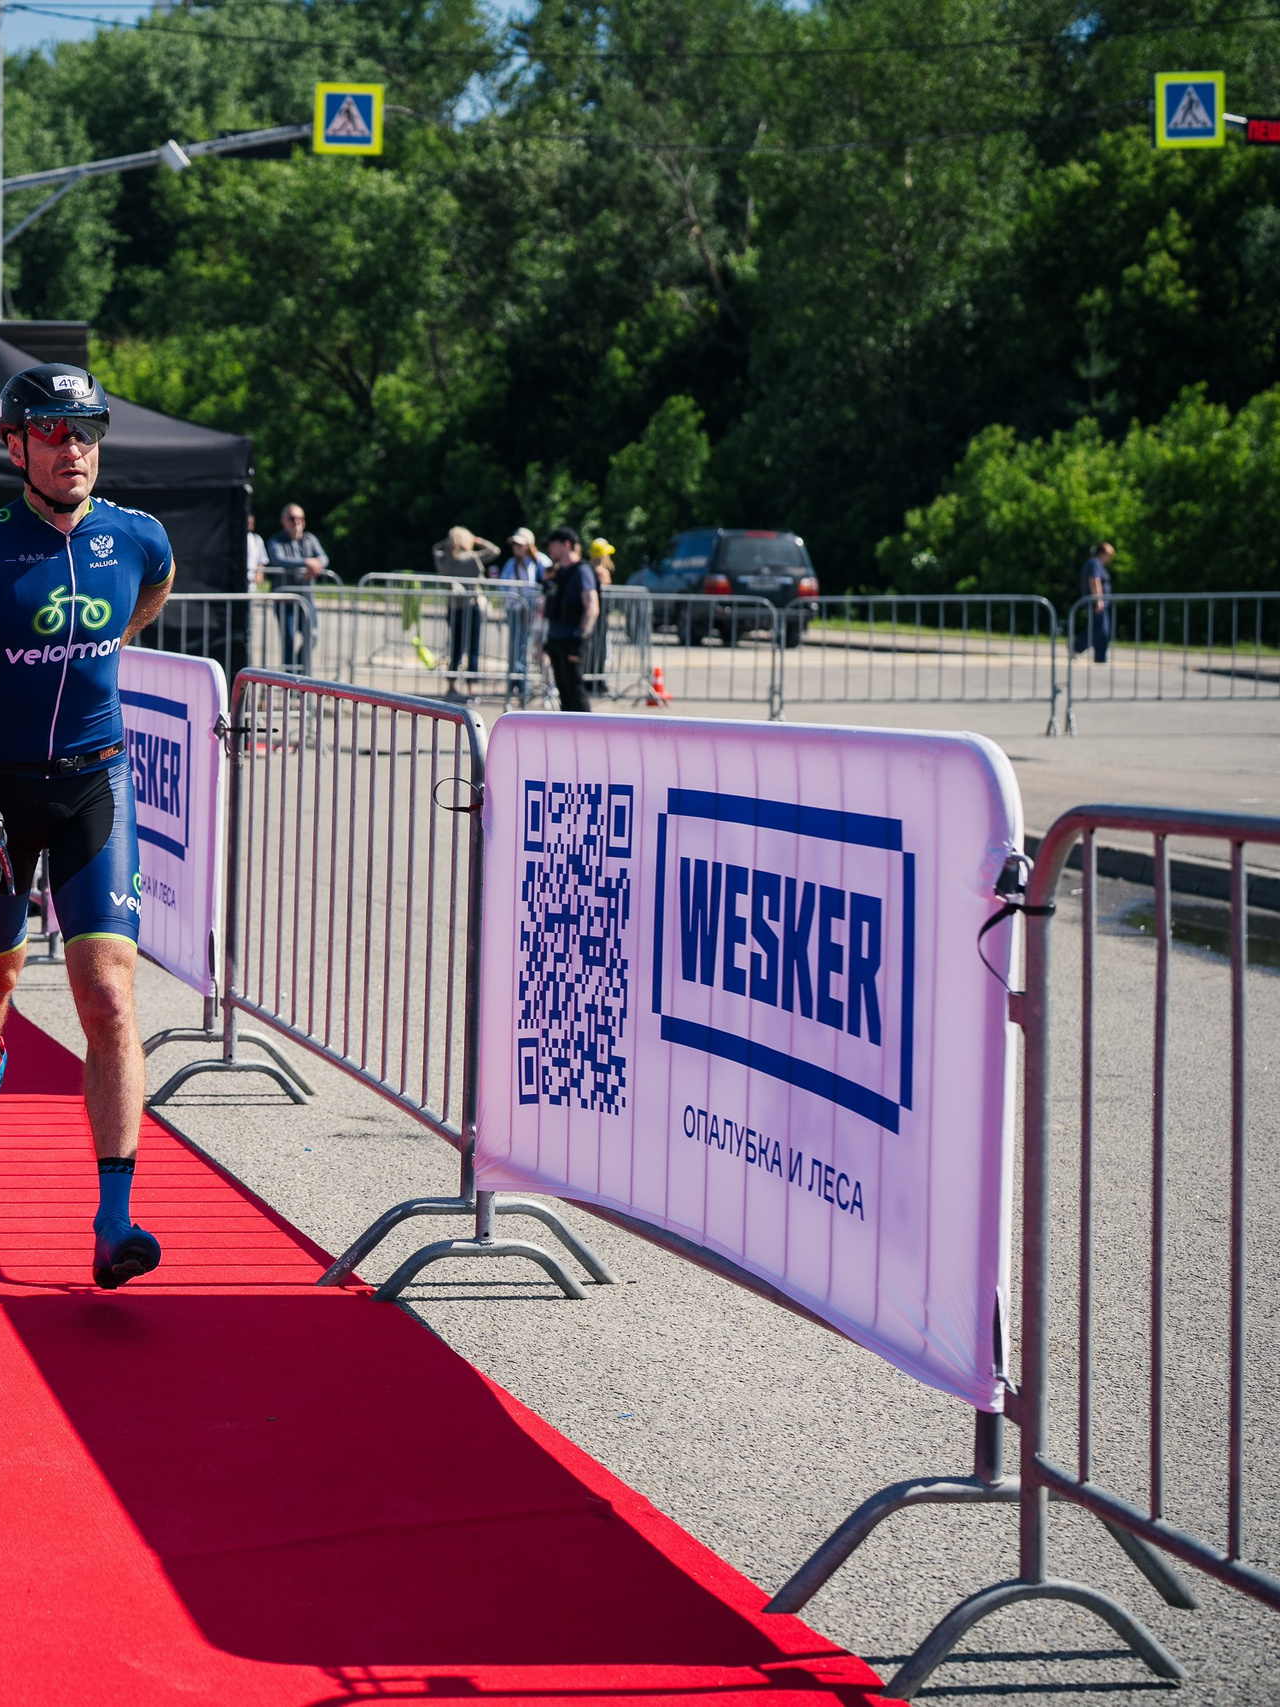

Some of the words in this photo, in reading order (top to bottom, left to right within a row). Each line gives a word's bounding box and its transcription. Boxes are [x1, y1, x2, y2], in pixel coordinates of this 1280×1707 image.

[89, 559, 119, 569] KALUGA
[5, 637, 121, 665] veloman
[125, 727, 181, 819] ESKER
[679, 856, 883, 1048] WESKER
[683, 1104, 783, 1173] ОПАЛУБКА
[788, 1146, 804, 1185] И
[808, 1159, 865, 1222] ЛЕСА
